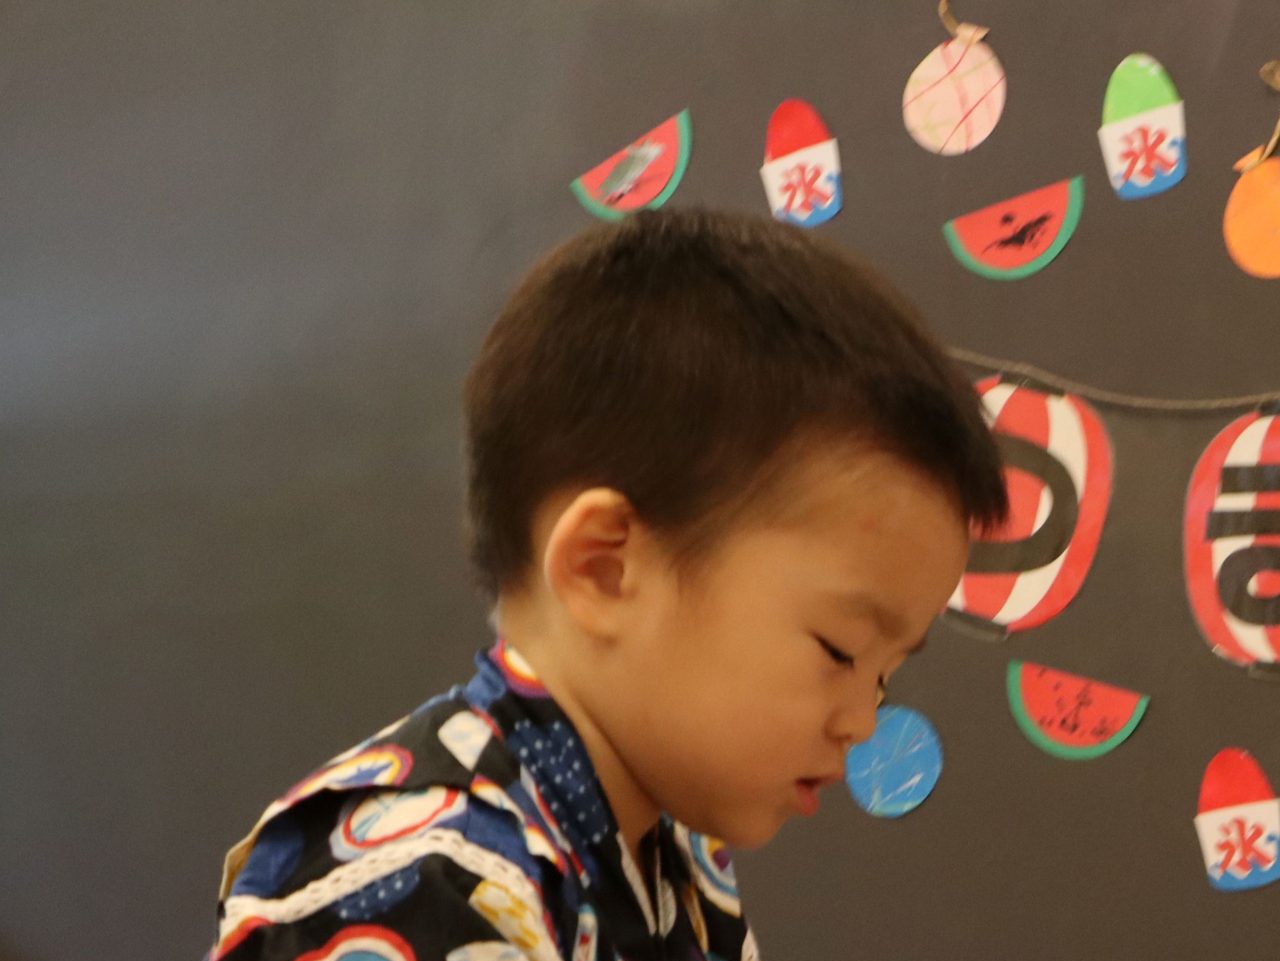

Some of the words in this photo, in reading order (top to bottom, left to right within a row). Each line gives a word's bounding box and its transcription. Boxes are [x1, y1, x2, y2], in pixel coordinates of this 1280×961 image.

[1120, 126, 1177, 181] 氷
[780, 164, 834, 215] 氷
[1216, 818, 1274, 874] 氷
